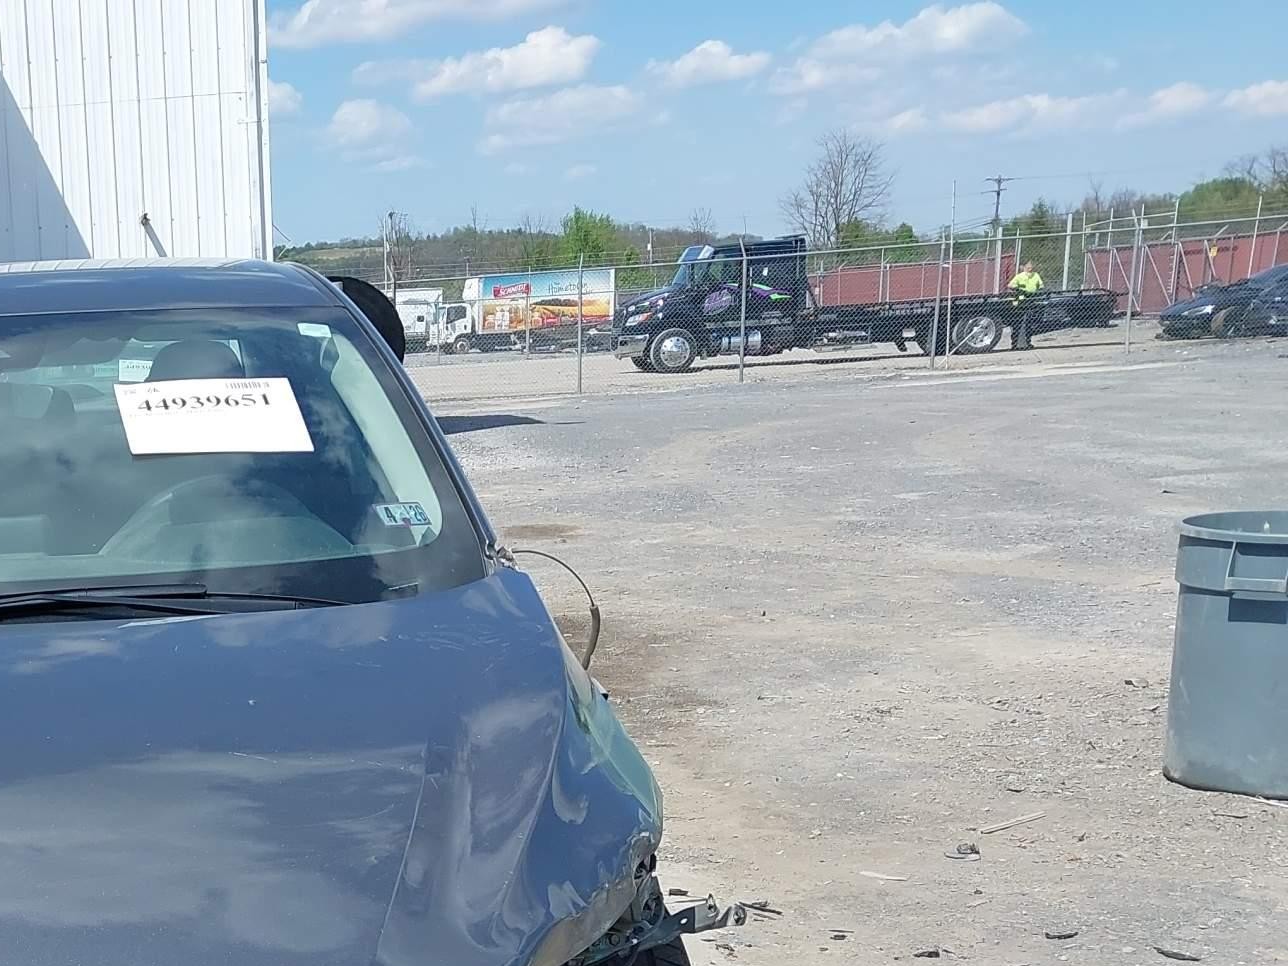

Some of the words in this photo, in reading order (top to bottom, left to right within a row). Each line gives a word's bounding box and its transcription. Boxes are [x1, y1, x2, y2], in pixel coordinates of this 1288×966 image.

[137, 393, 271, 412] 44939651
[383, 506, 398, 524] 4
[408, 504, 429, 522] 26
